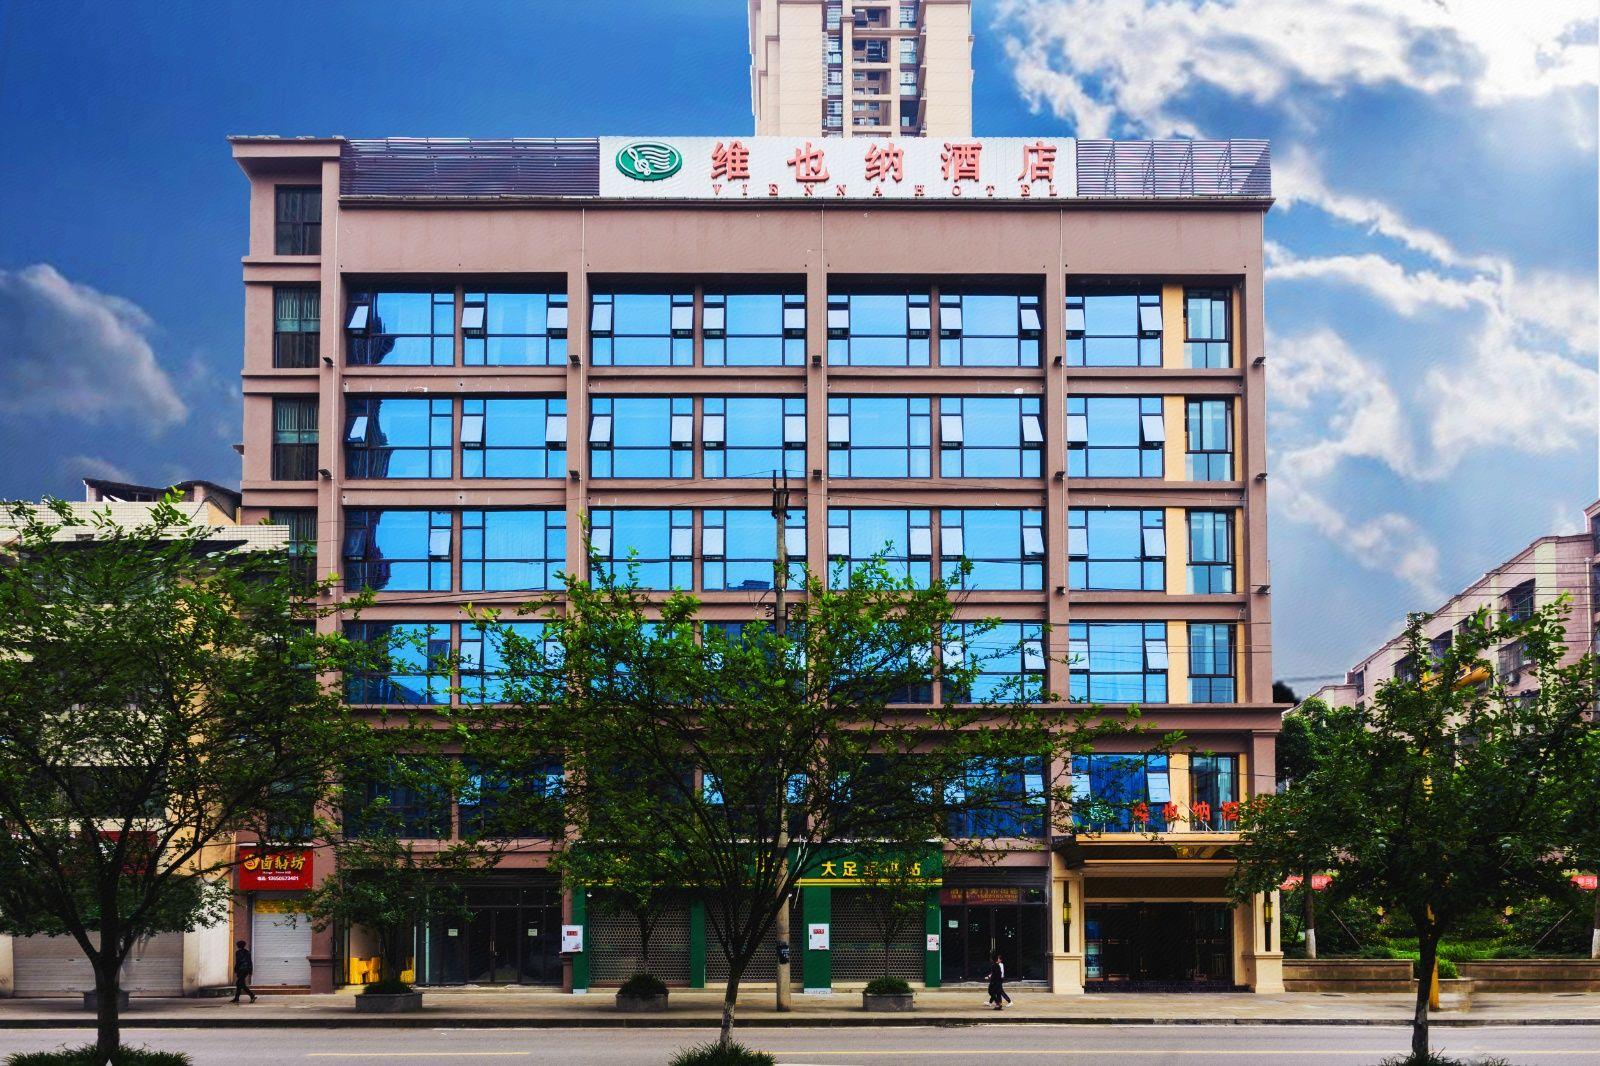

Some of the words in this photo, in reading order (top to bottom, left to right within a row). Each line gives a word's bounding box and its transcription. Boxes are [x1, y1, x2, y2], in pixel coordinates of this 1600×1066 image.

[711, 140, 1057, 182] 维也纳酒店
[712, 184, 882, 197] VIENNA
[914, 184, 1057, 197] HOTEL
